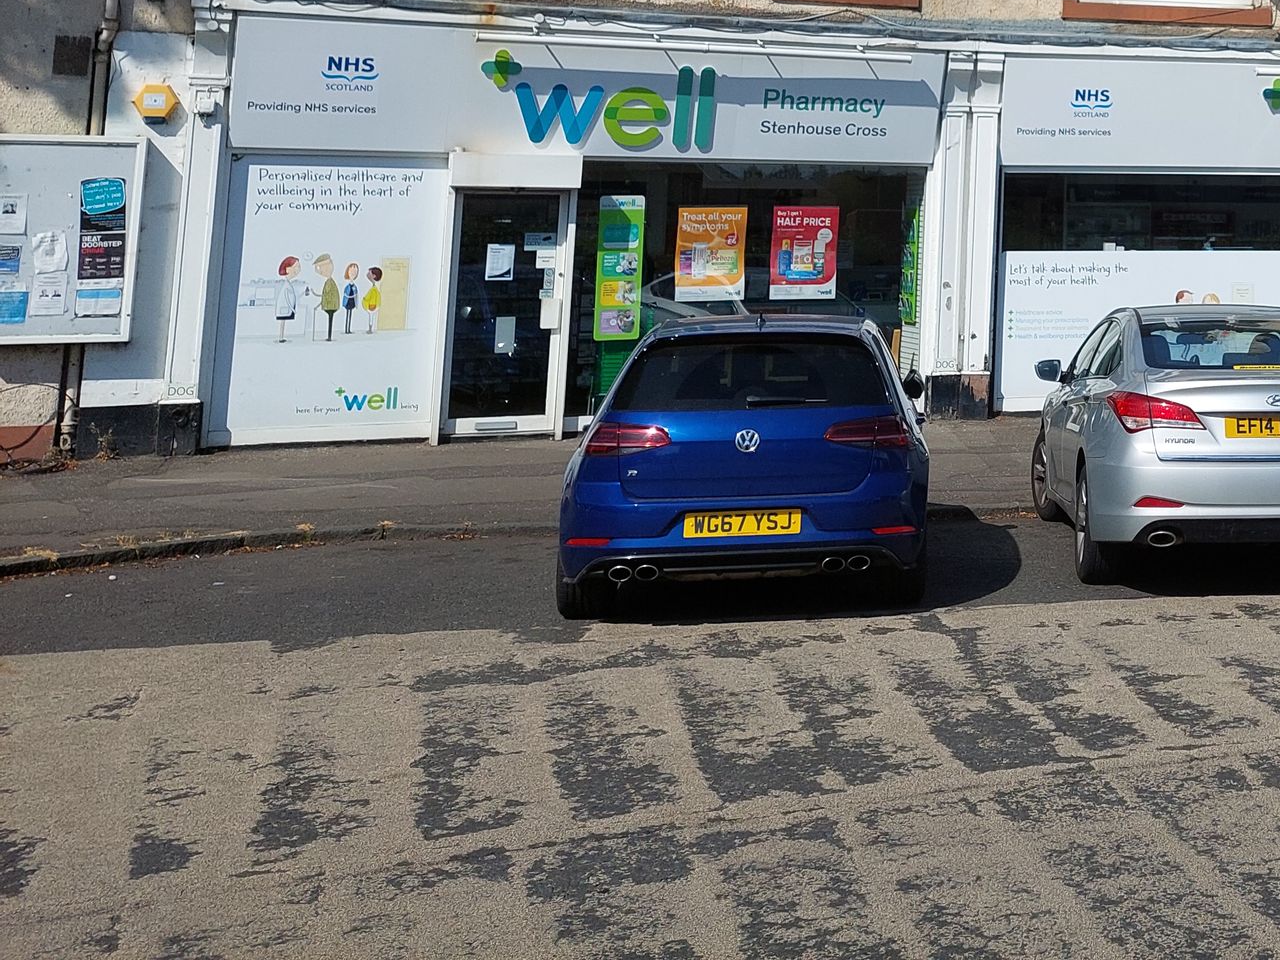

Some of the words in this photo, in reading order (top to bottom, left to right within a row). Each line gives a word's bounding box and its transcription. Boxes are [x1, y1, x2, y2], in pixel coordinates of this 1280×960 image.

[327, 56, 375, 72] NHS
[325, 83, 374, 92] SCOTLAND
[1075, 89, 1110, 102] NHS
[247, 101, 301, 114] Providing
[304, 103, 329, 112] NHS
[331, 105, 377, 114] services
[515, 65, 716, 153] well
[763, 88, 886, 119] Pharmacy
[760, 120, 842, 135] Stenhouse
[845, 123, 888, 137] Cross
[1016, 127, 1056, 137] Providing
[1058, 128, 1076, 136] NHS
[1078, 128, 1112, 136] services
[259, 168, 333, 182] Personalised
[337, 169, 397, 182] healthcare
[402, 171, 424, 182] and
[257, 183, 315, 201] wellbeing
[320, 185, 332, 196] in
[339, 184, 357, 196] the
[363, 184, 394, 197] heart
[398, 184, 412, 197] of
[255, 201, 284, 215] your
[682, 212, 705, 221] Treat
[708, 212, 719, 220] all
[721, 213, 742, 222] your
[777, 217, 802, 226] HALF
[803, 217, 832, 227] PRICE
[682, 223, 729, 232] symptoms
[1009, 263, 1028, 275] Let's
[1032, 262, 1047, 273] talk
[1050, 262, 1075, 273] about
[1078, 262, 1111, 277] making
[1115, 262, 1129, 273] the
[1009, 276, 1031, 286] most
[1035, 275, 1045, 285] of
[1047, 278, 1067, 289] your
[936, 360, 955, 369] DOG
[167, 386, 194, 396] DOG
[296, 406, 310, 414] here
[325, 407, 341, 415] your
[343, 386, 399, 411] well
[400, 403, 419, 412] being
[1236, 417, 1274, 434] EF14
[694, 513, 747, 534] WG67
[752, 512, 792, 531] YSJ
